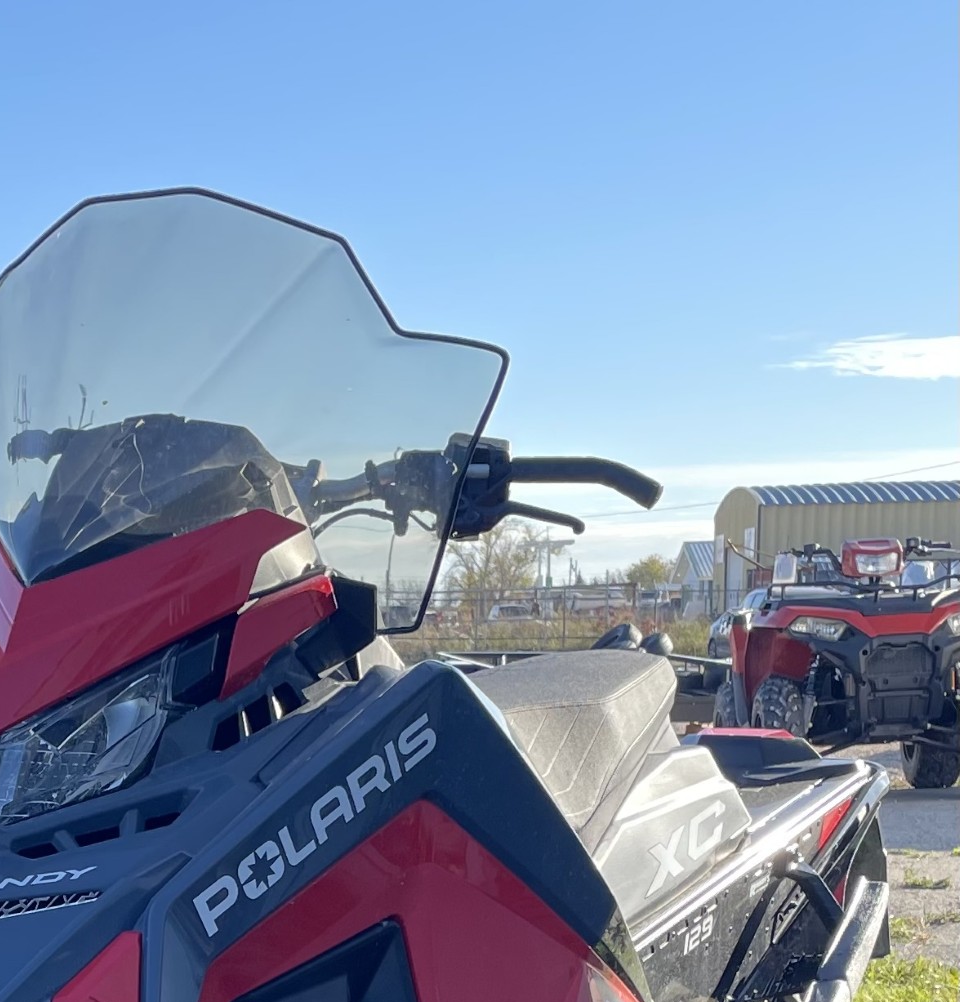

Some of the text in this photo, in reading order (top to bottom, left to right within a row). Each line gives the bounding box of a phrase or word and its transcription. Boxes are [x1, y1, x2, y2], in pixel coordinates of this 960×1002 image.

[192, 712, 438, 938] POLARIS
[644, 800, 727, 900] XC
[683, 914, 714, 956] 129
